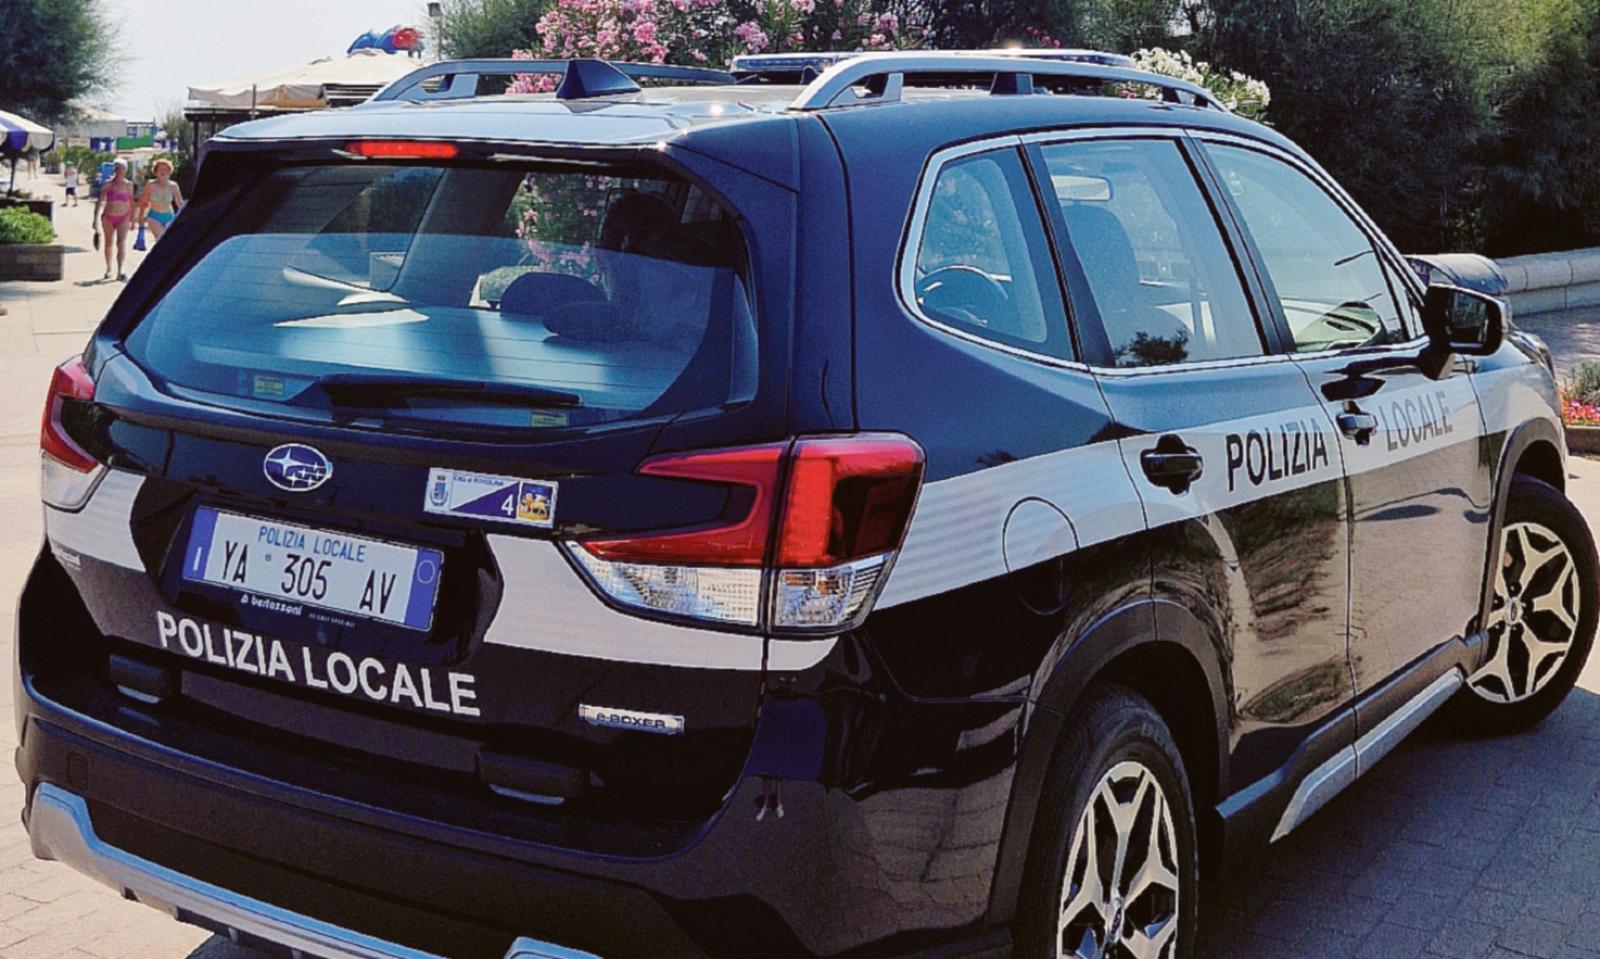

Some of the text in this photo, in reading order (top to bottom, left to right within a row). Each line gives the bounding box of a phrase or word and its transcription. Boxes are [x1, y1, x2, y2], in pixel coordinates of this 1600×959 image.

[1226, 391, 1453, 492] POLIZIA LOCALE
[501, 494, 514, 516] 4
[258, 526, 366, 563] POLIZIA LOCALE
[222, 540, 397, 614] YA 305 AV
[157, 612, 481, 716] POLIZIA LOCALE
[597, 712, 666, 729] e-BOXER
